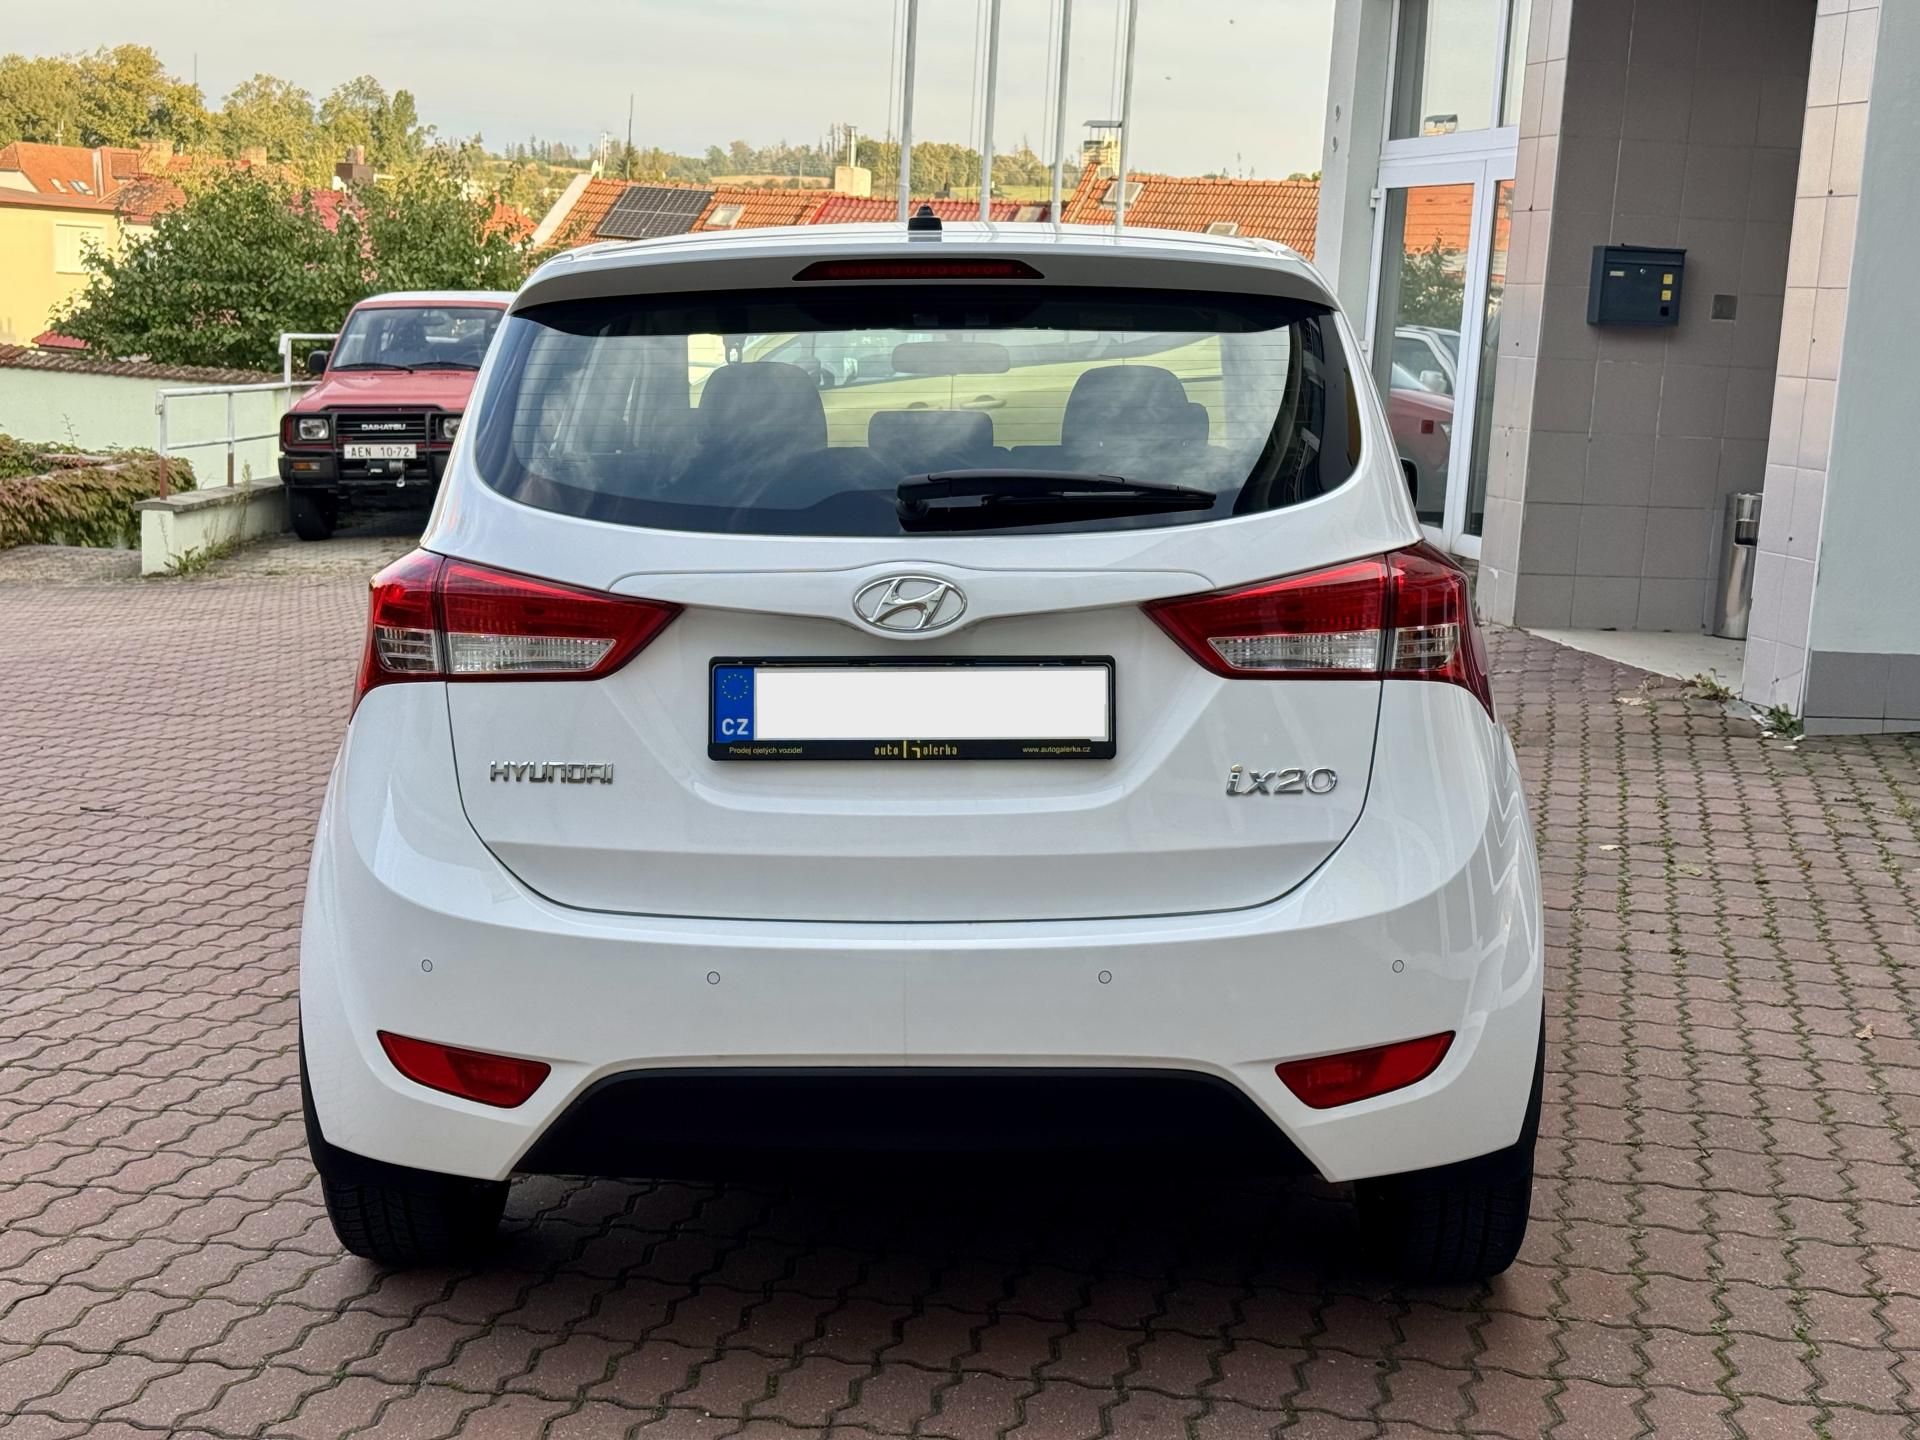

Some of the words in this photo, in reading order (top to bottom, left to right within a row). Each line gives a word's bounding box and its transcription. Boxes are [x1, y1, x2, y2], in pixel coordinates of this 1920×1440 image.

[361, 423, 406, 431] DAIHATSU
[351, 447, 372, 457] AEN
[722, 718, 749, 735] CZ
[729, 746, 752, 755] Prodej
[778, 746, 803, 754] vozidel
[1022, 746, 1091, 754] www.autogalerka.cz
[490, 761, 614, 784] HYUNDAI
[1226, 764, 1337, 795] ix20
